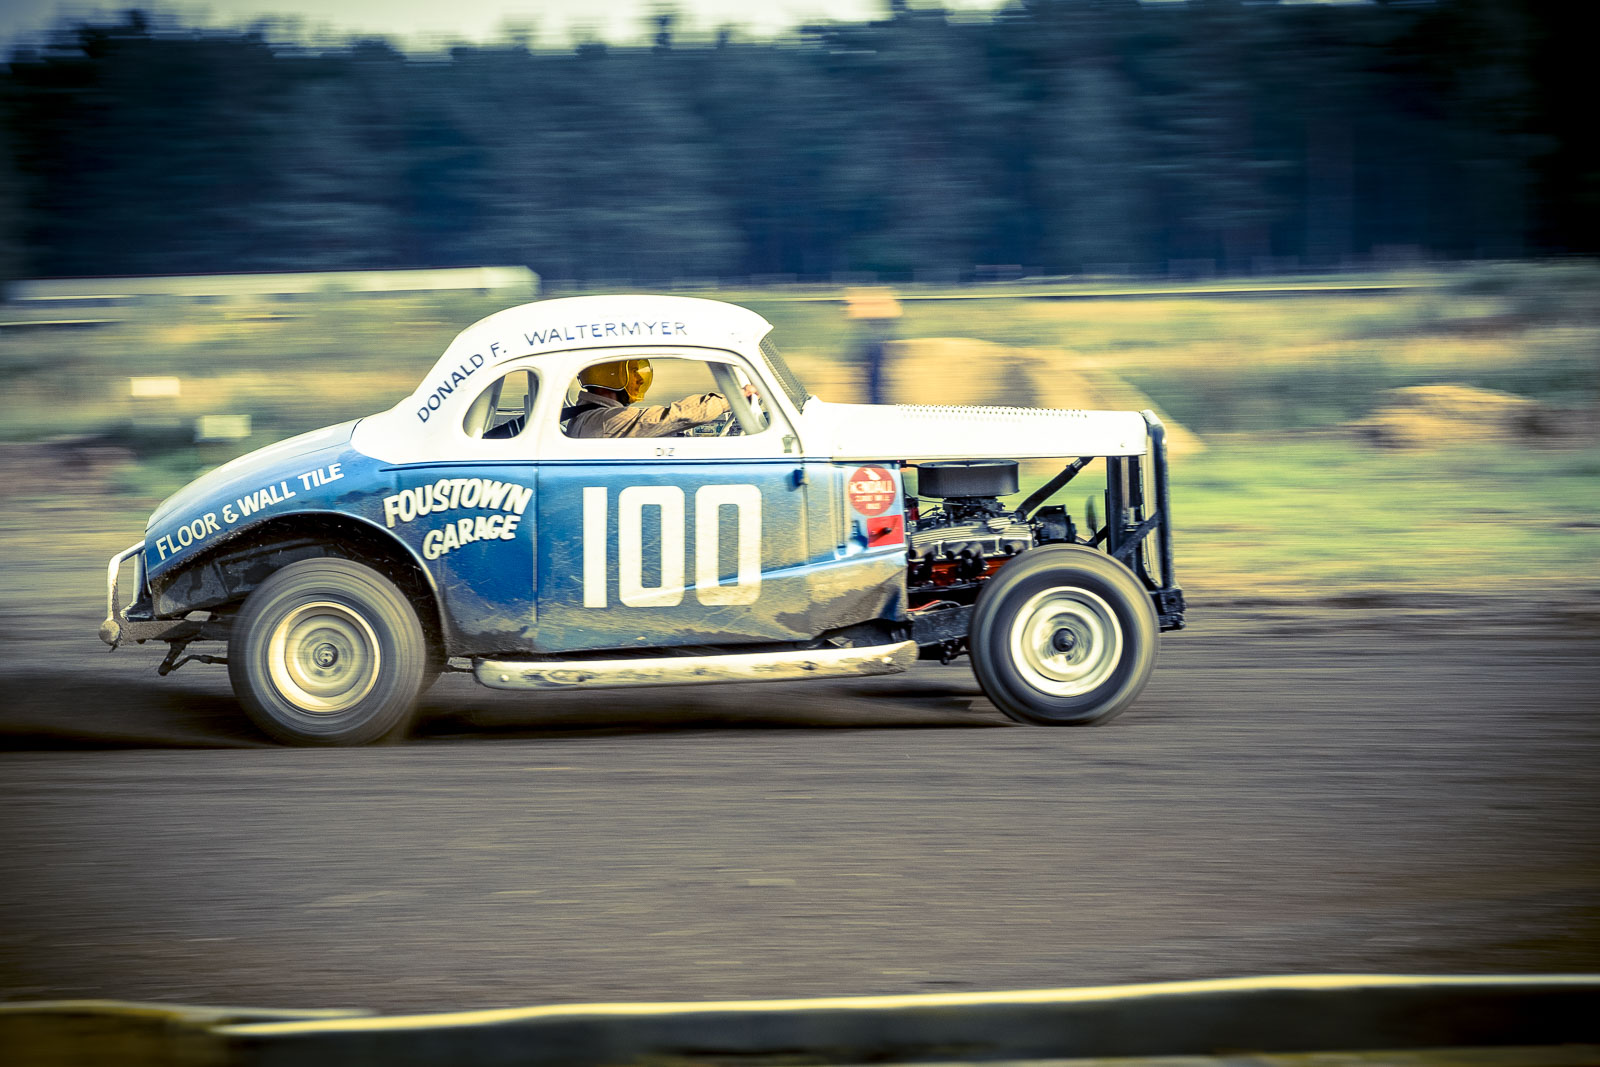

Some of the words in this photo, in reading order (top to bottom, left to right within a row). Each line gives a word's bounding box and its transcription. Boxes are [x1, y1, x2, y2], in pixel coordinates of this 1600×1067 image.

[416, 354, 484, 423] DONALD
[491, 343, 507, 357] F.
[525, 322, 688, 345] WALTERMYER
[157, 514, 221, 560] FLOOR
[223, 505, 239, 524] &
[238, 482, 296, 516] WALL
[299, 464, 344, 491] TILE
[383, 479, 533, 528] FOUSTOWN
[422, 516, 521, 560] GARAGE
[584, 484, 762, 608] 100
